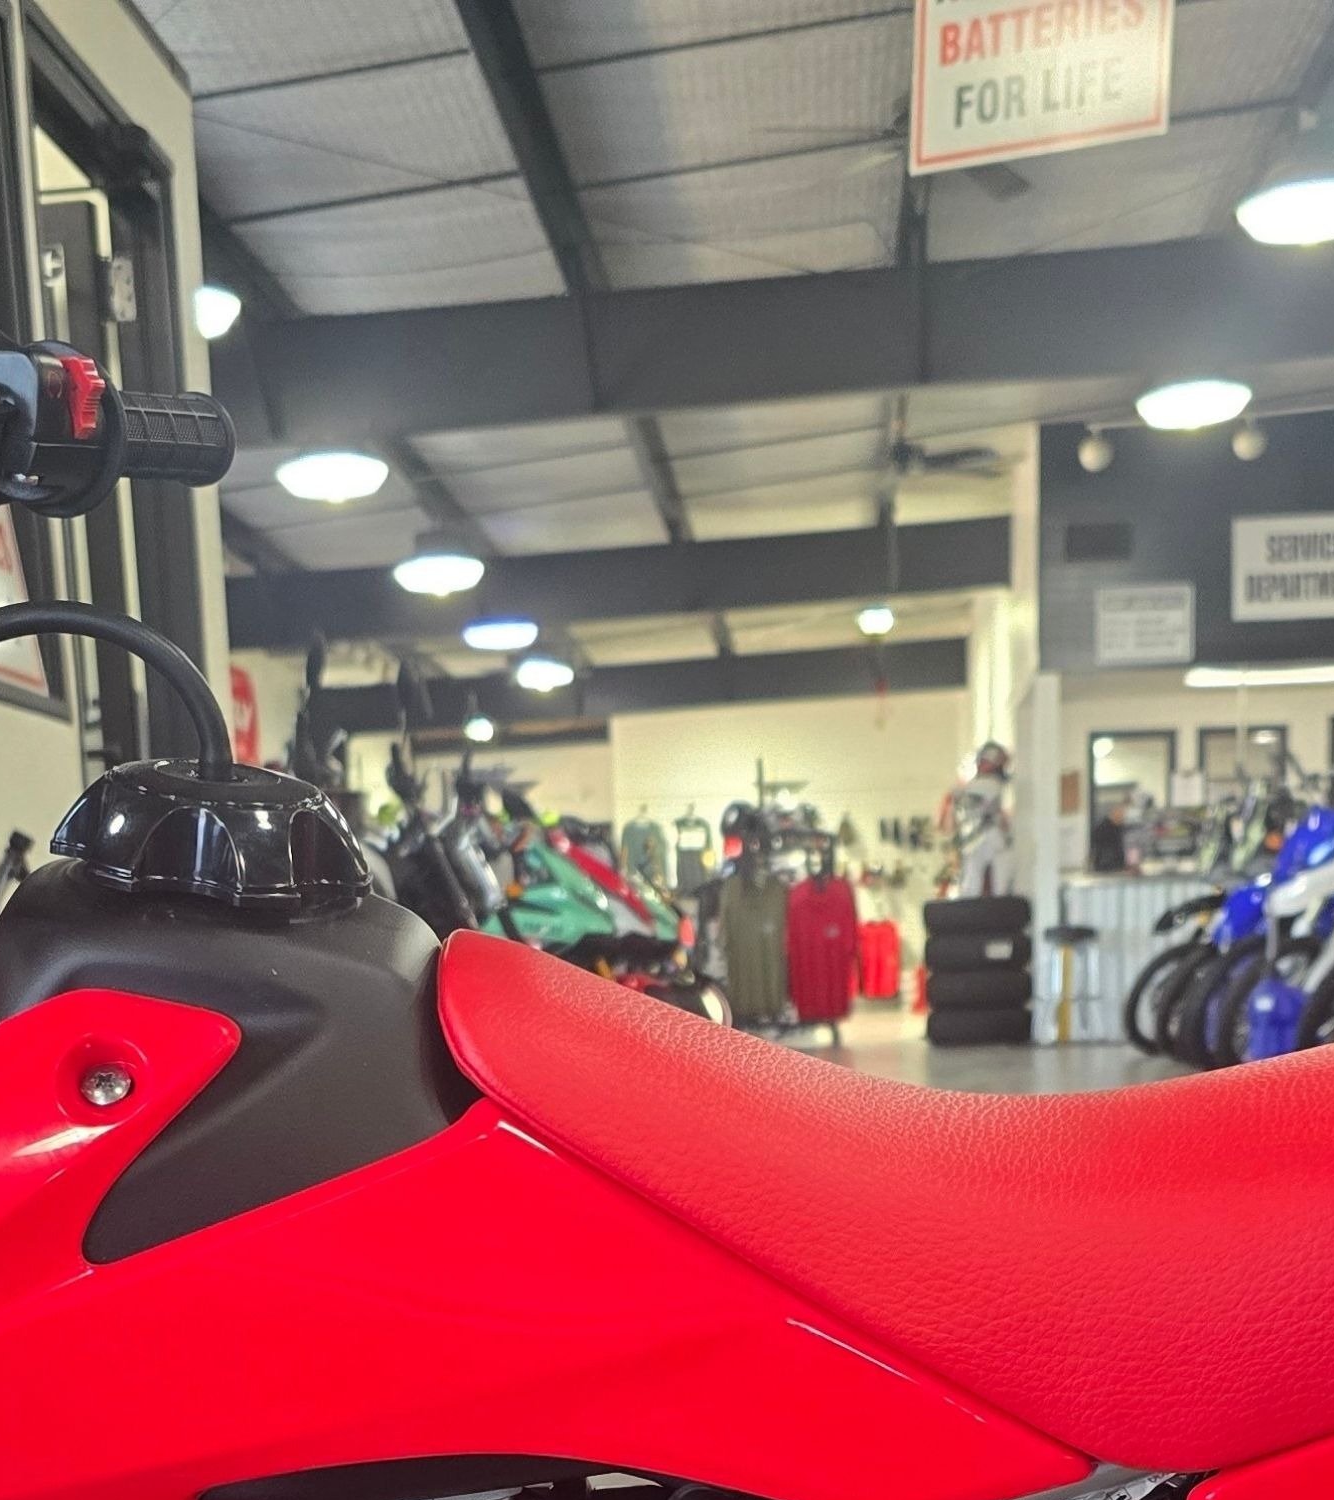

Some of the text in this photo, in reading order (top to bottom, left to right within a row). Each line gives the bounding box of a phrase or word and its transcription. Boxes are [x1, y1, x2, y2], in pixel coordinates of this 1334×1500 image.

[938, 0, 1146, 68] BATTERIES
[954, 57, 1123, 129] FOR LIFE
